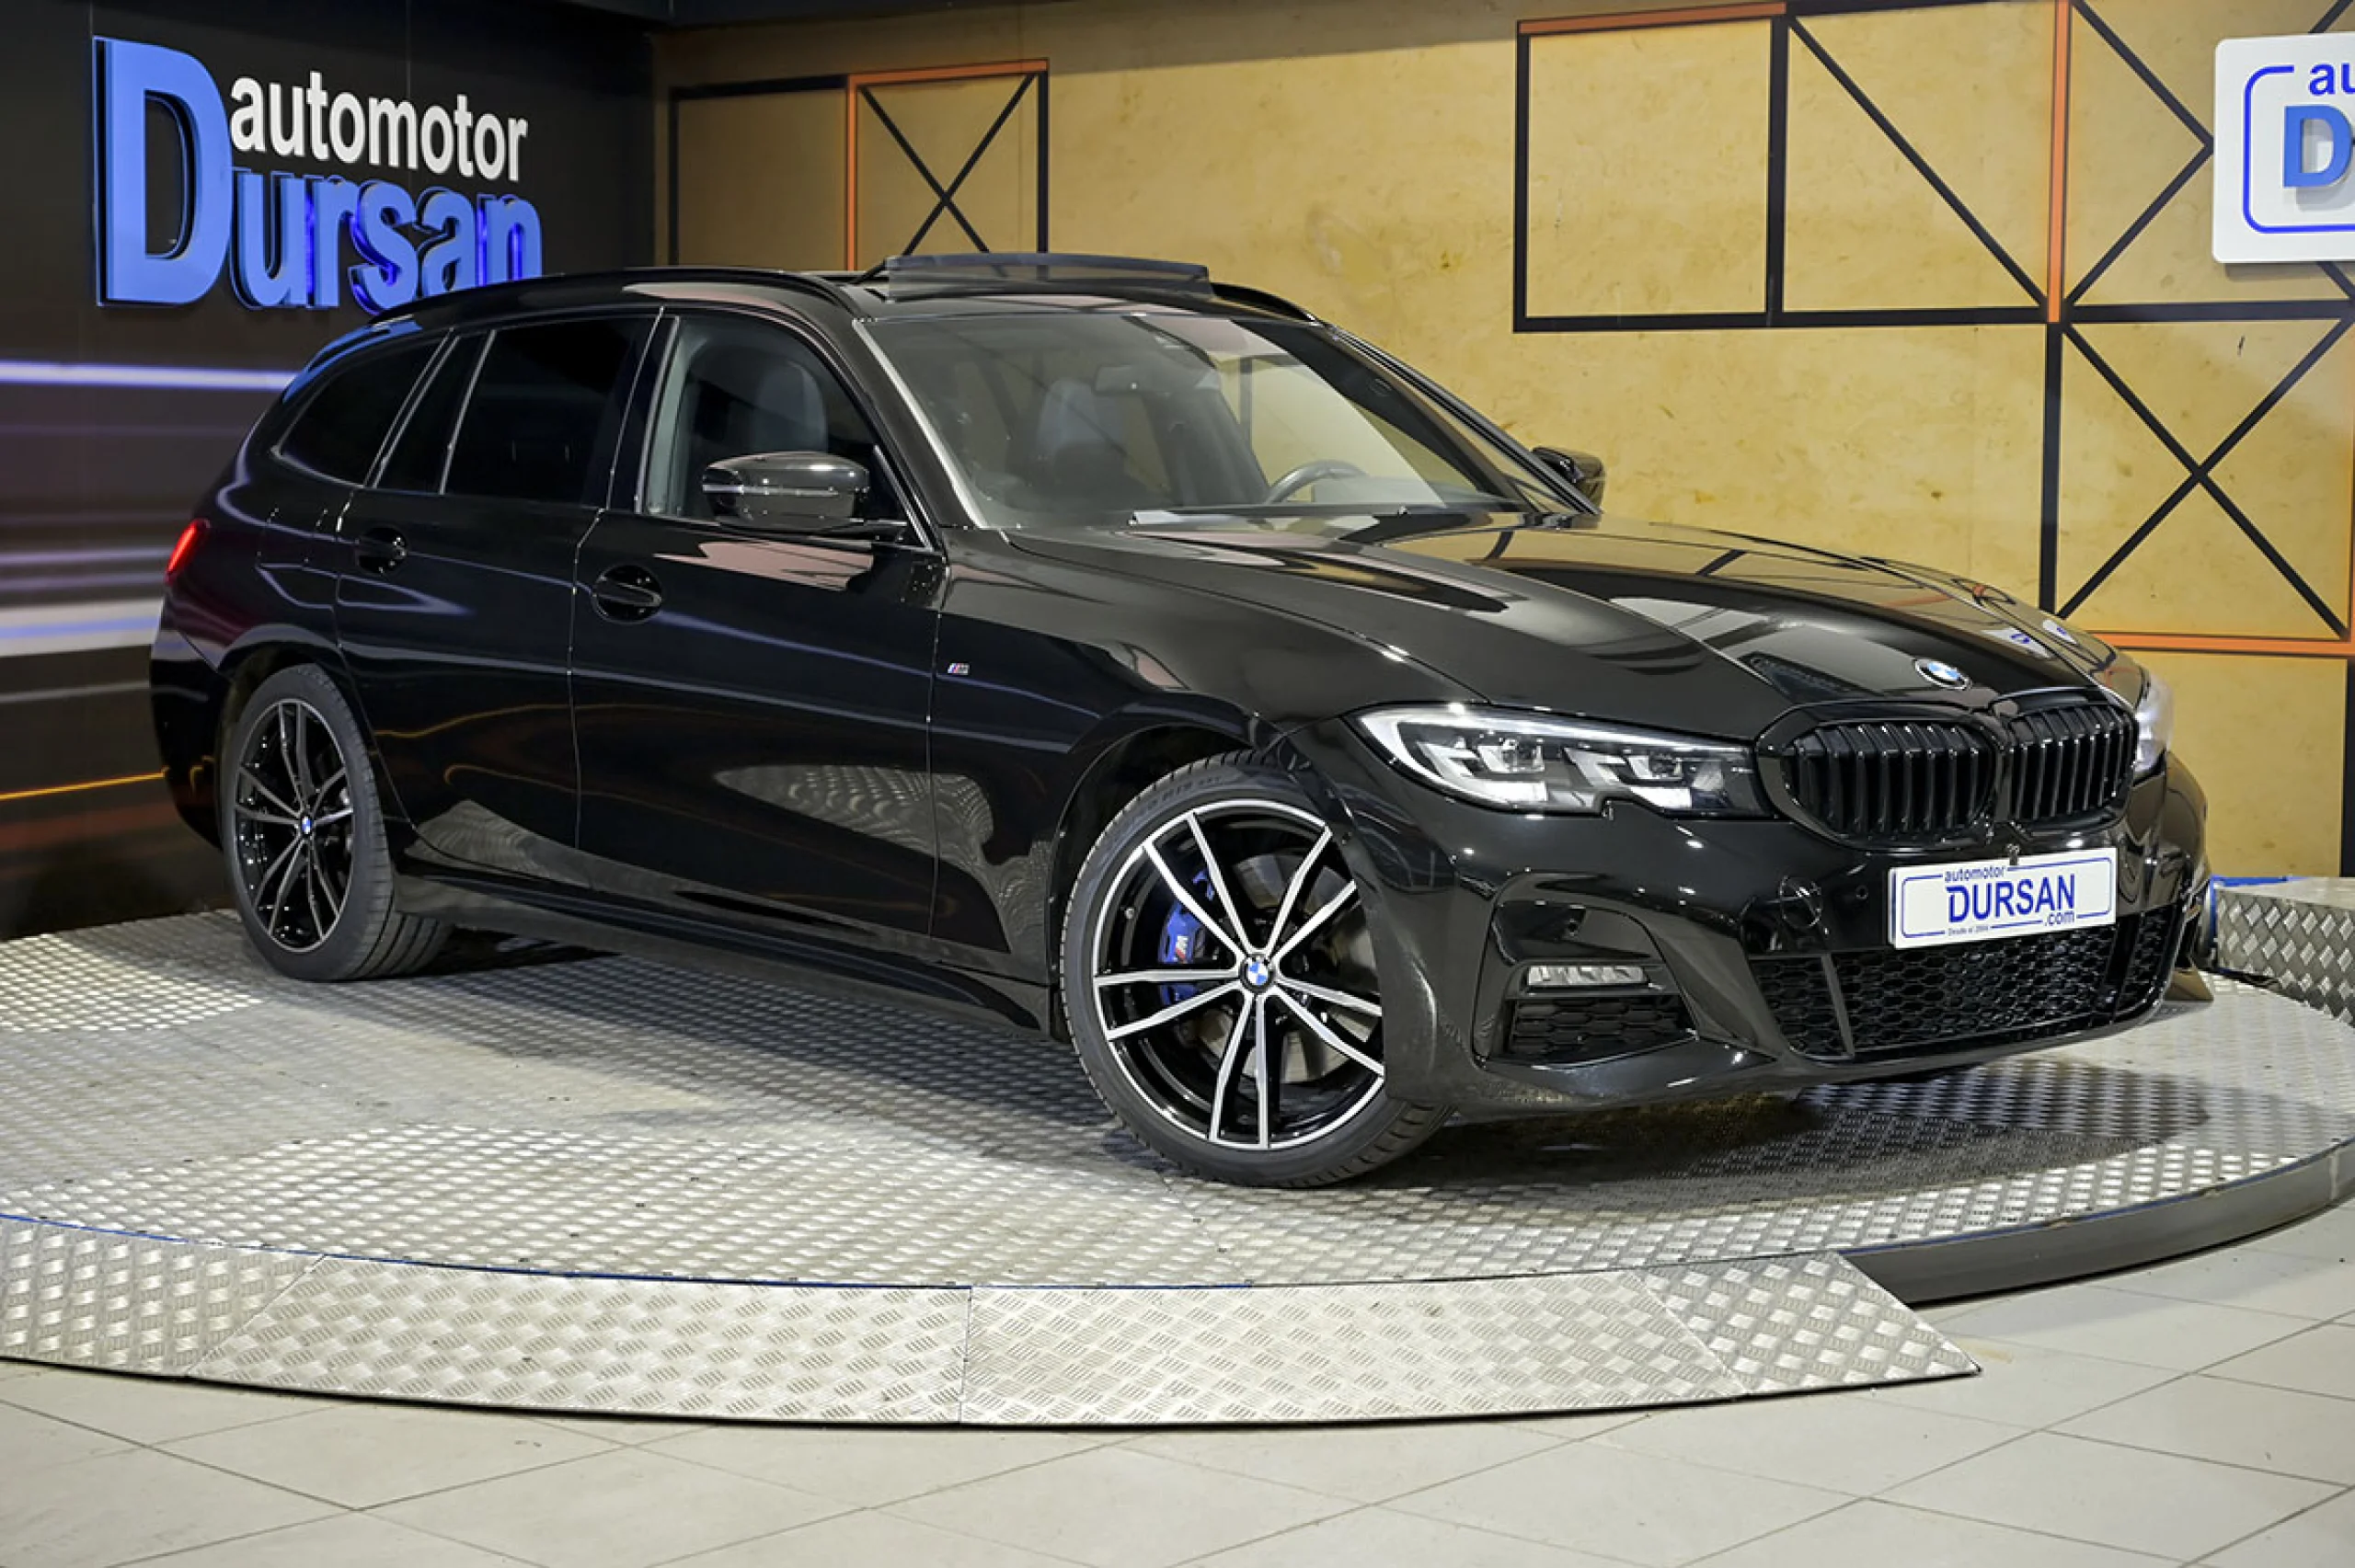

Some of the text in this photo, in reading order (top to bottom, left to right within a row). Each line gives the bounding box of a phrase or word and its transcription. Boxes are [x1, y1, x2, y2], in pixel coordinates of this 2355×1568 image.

[230, 70, 529, 182] automotor
[94, 36, 543, 315] Dursan
[1945, 865, 2005, 882] automotor
[1946, 873, 2075, 923] DURSAN
[2043, 910, 2075, 927] .com
